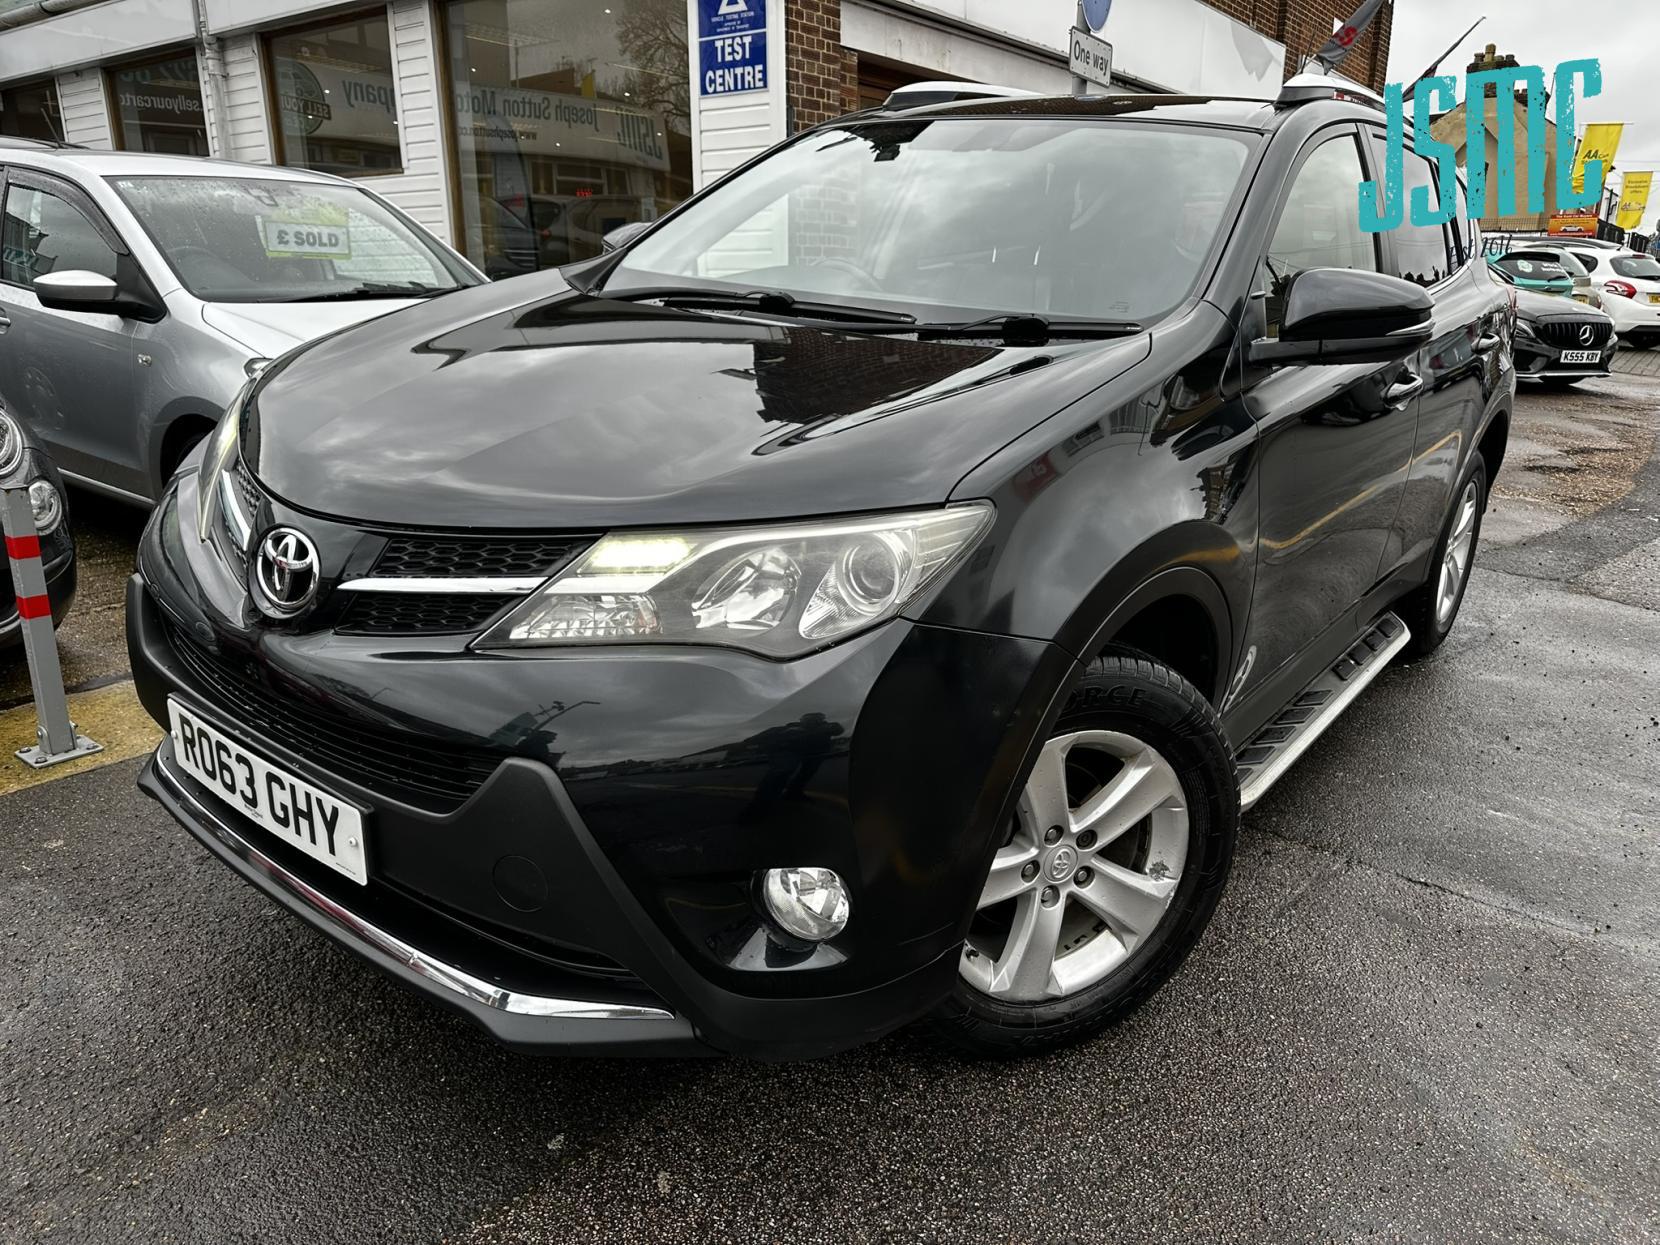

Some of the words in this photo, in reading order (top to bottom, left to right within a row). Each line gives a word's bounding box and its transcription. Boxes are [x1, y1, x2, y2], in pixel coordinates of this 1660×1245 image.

[714, 35, 752, 63] TEST
[1074, 40, 1091, 65] One
[1093, 53, 1109, 76] way
[705, 64, 764, 93] CENTRE
[1582, 149, 1599, 160] AA
[293, 231, 339, 248] SOLD
[1563, 352, 1585, 361] K555
[178, 712, 258, 809] RO63
[265, 770, 339, 857] GHY
